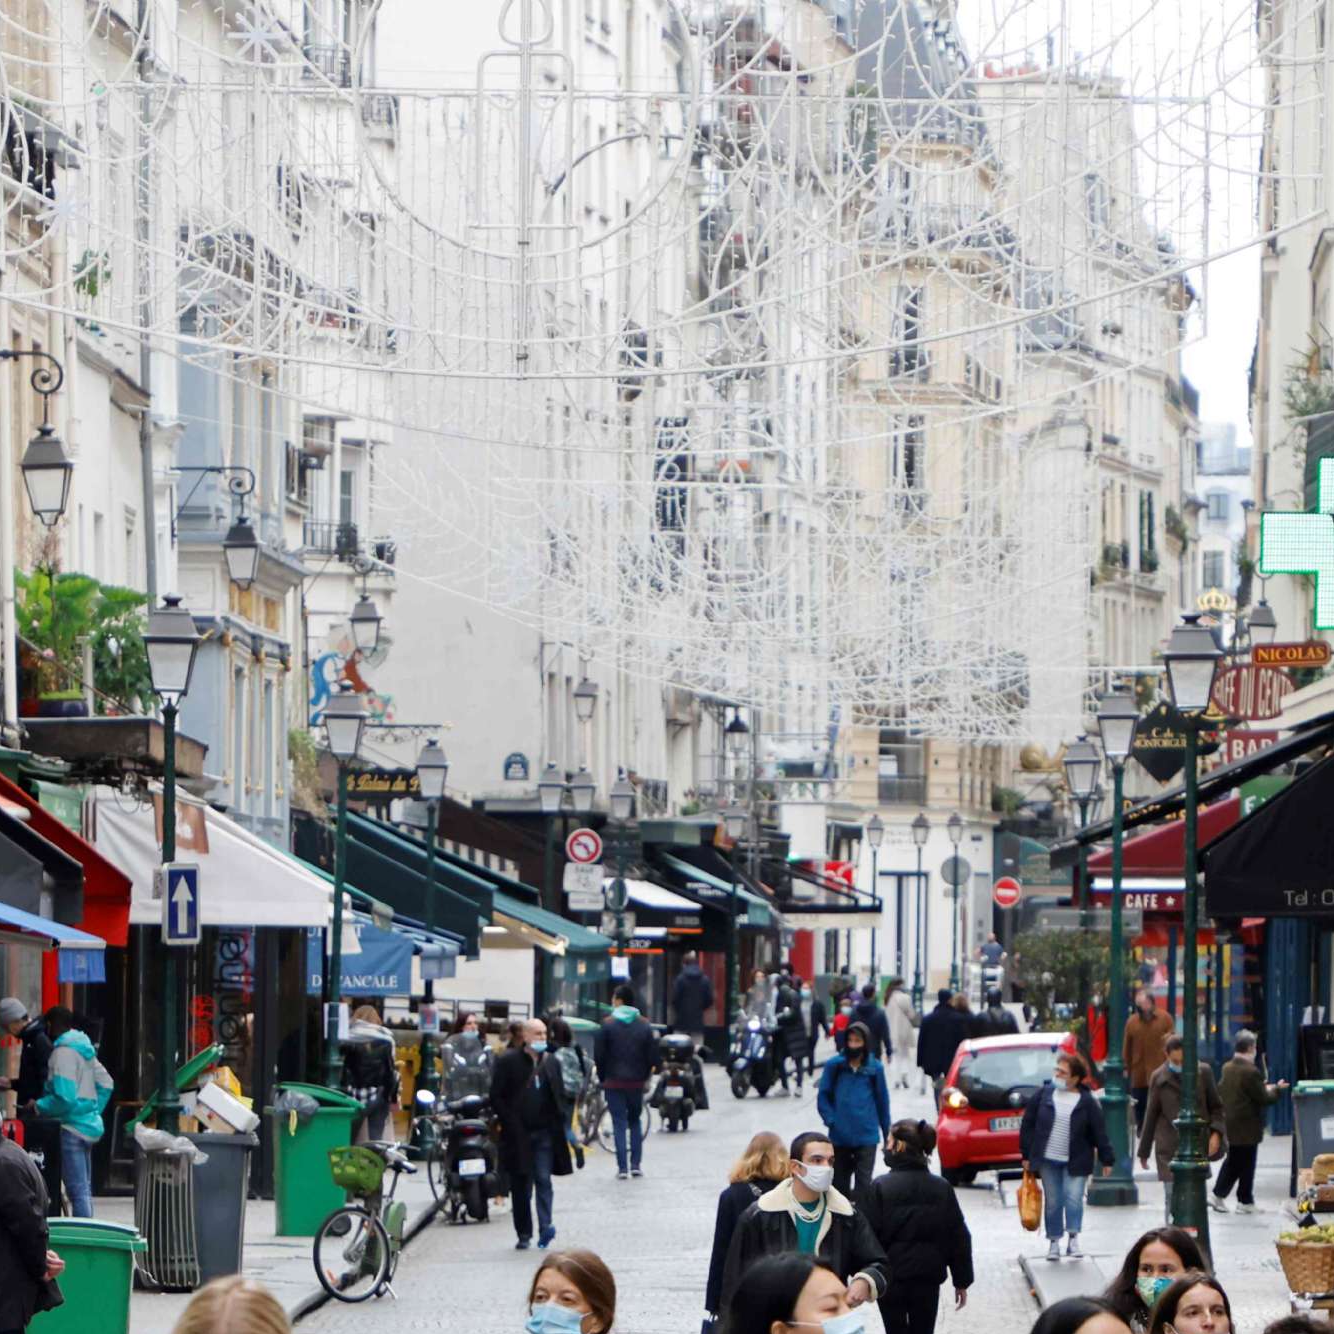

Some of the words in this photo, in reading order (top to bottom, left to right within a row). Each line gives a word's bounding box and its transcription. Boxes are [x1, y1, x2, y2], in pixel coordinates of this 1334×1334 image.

[1257, 647, 1327, 661] NICOLAS
[1125, 893, 1159, 909] CAFE
[1283, 889, 1308, 907] Tel
